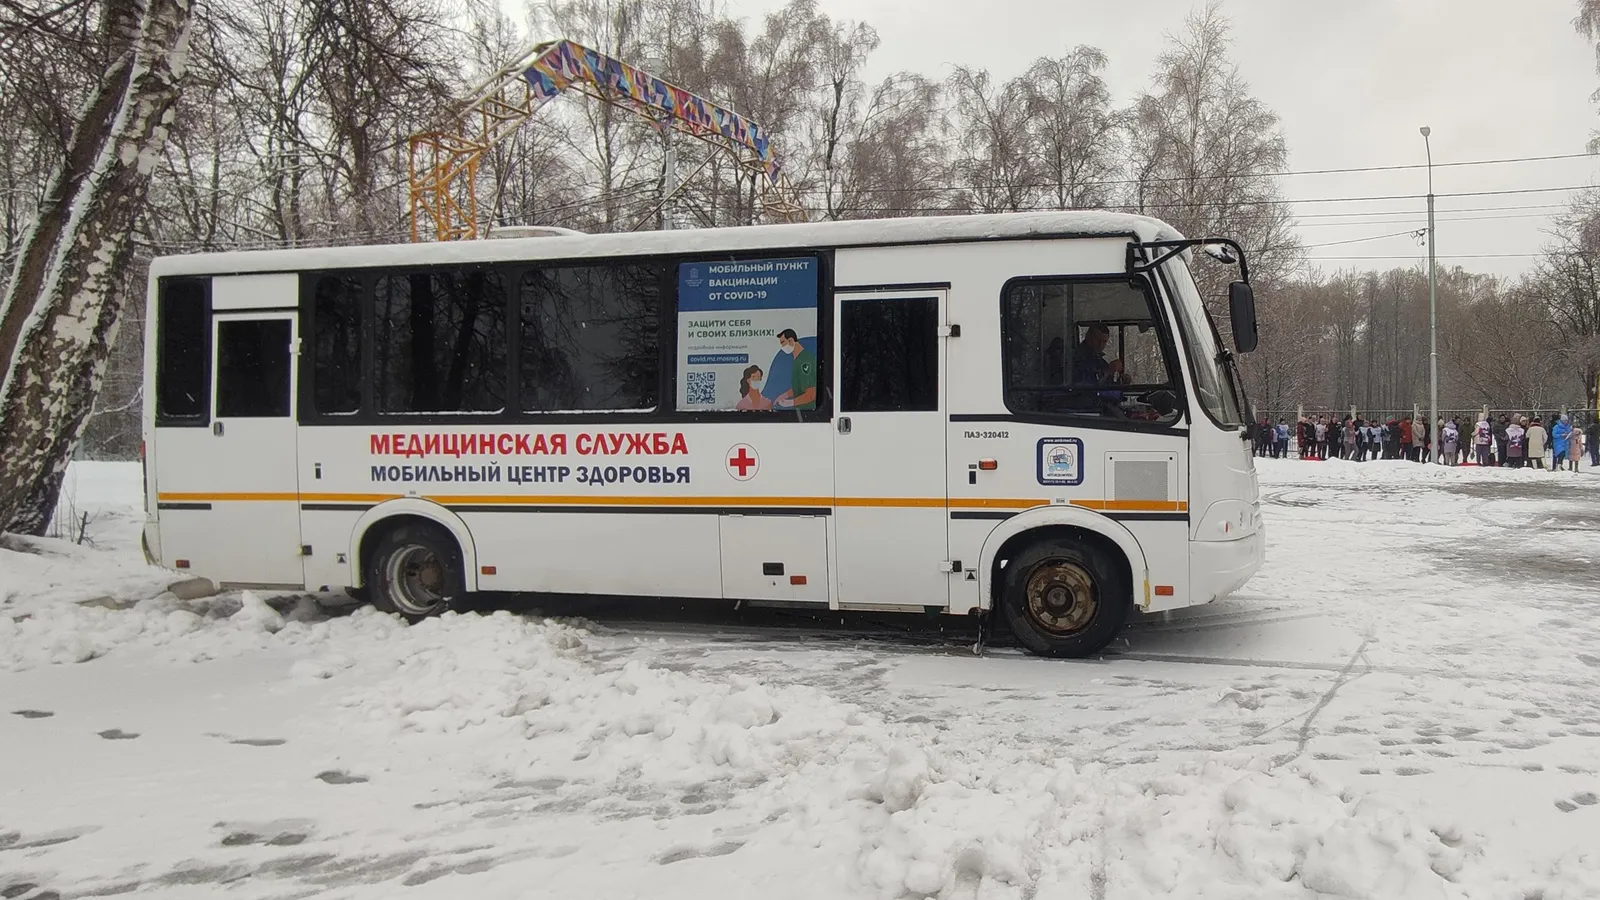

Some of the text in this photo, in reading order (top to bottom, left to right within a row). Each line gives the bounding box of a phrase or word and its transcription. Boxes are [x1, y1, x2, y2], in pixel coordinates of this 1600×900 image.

[709, 262, 809, 274] МОБИЛЬНЫЙ ПУНКТ
[709, 277, 778, 288] ВАКЦИНАЦИИ
[709, 291, 767, 300] ОТ COVID-19
[688, 319, 751, 328] ЗАЩИТИ СЕБЯ
[729, 329, 774, 338] БЛИЗКИХ!
[964, 431, 1009, 439] ПАЗ-320412
[370, 433, 689, 458] МЕДИЦИНСКАЯ СЛУЖБА
[371, 461, 690, 486] МОБИЛЬНЫЙ ЦЕНТР ЗДОРОВЬЯ
